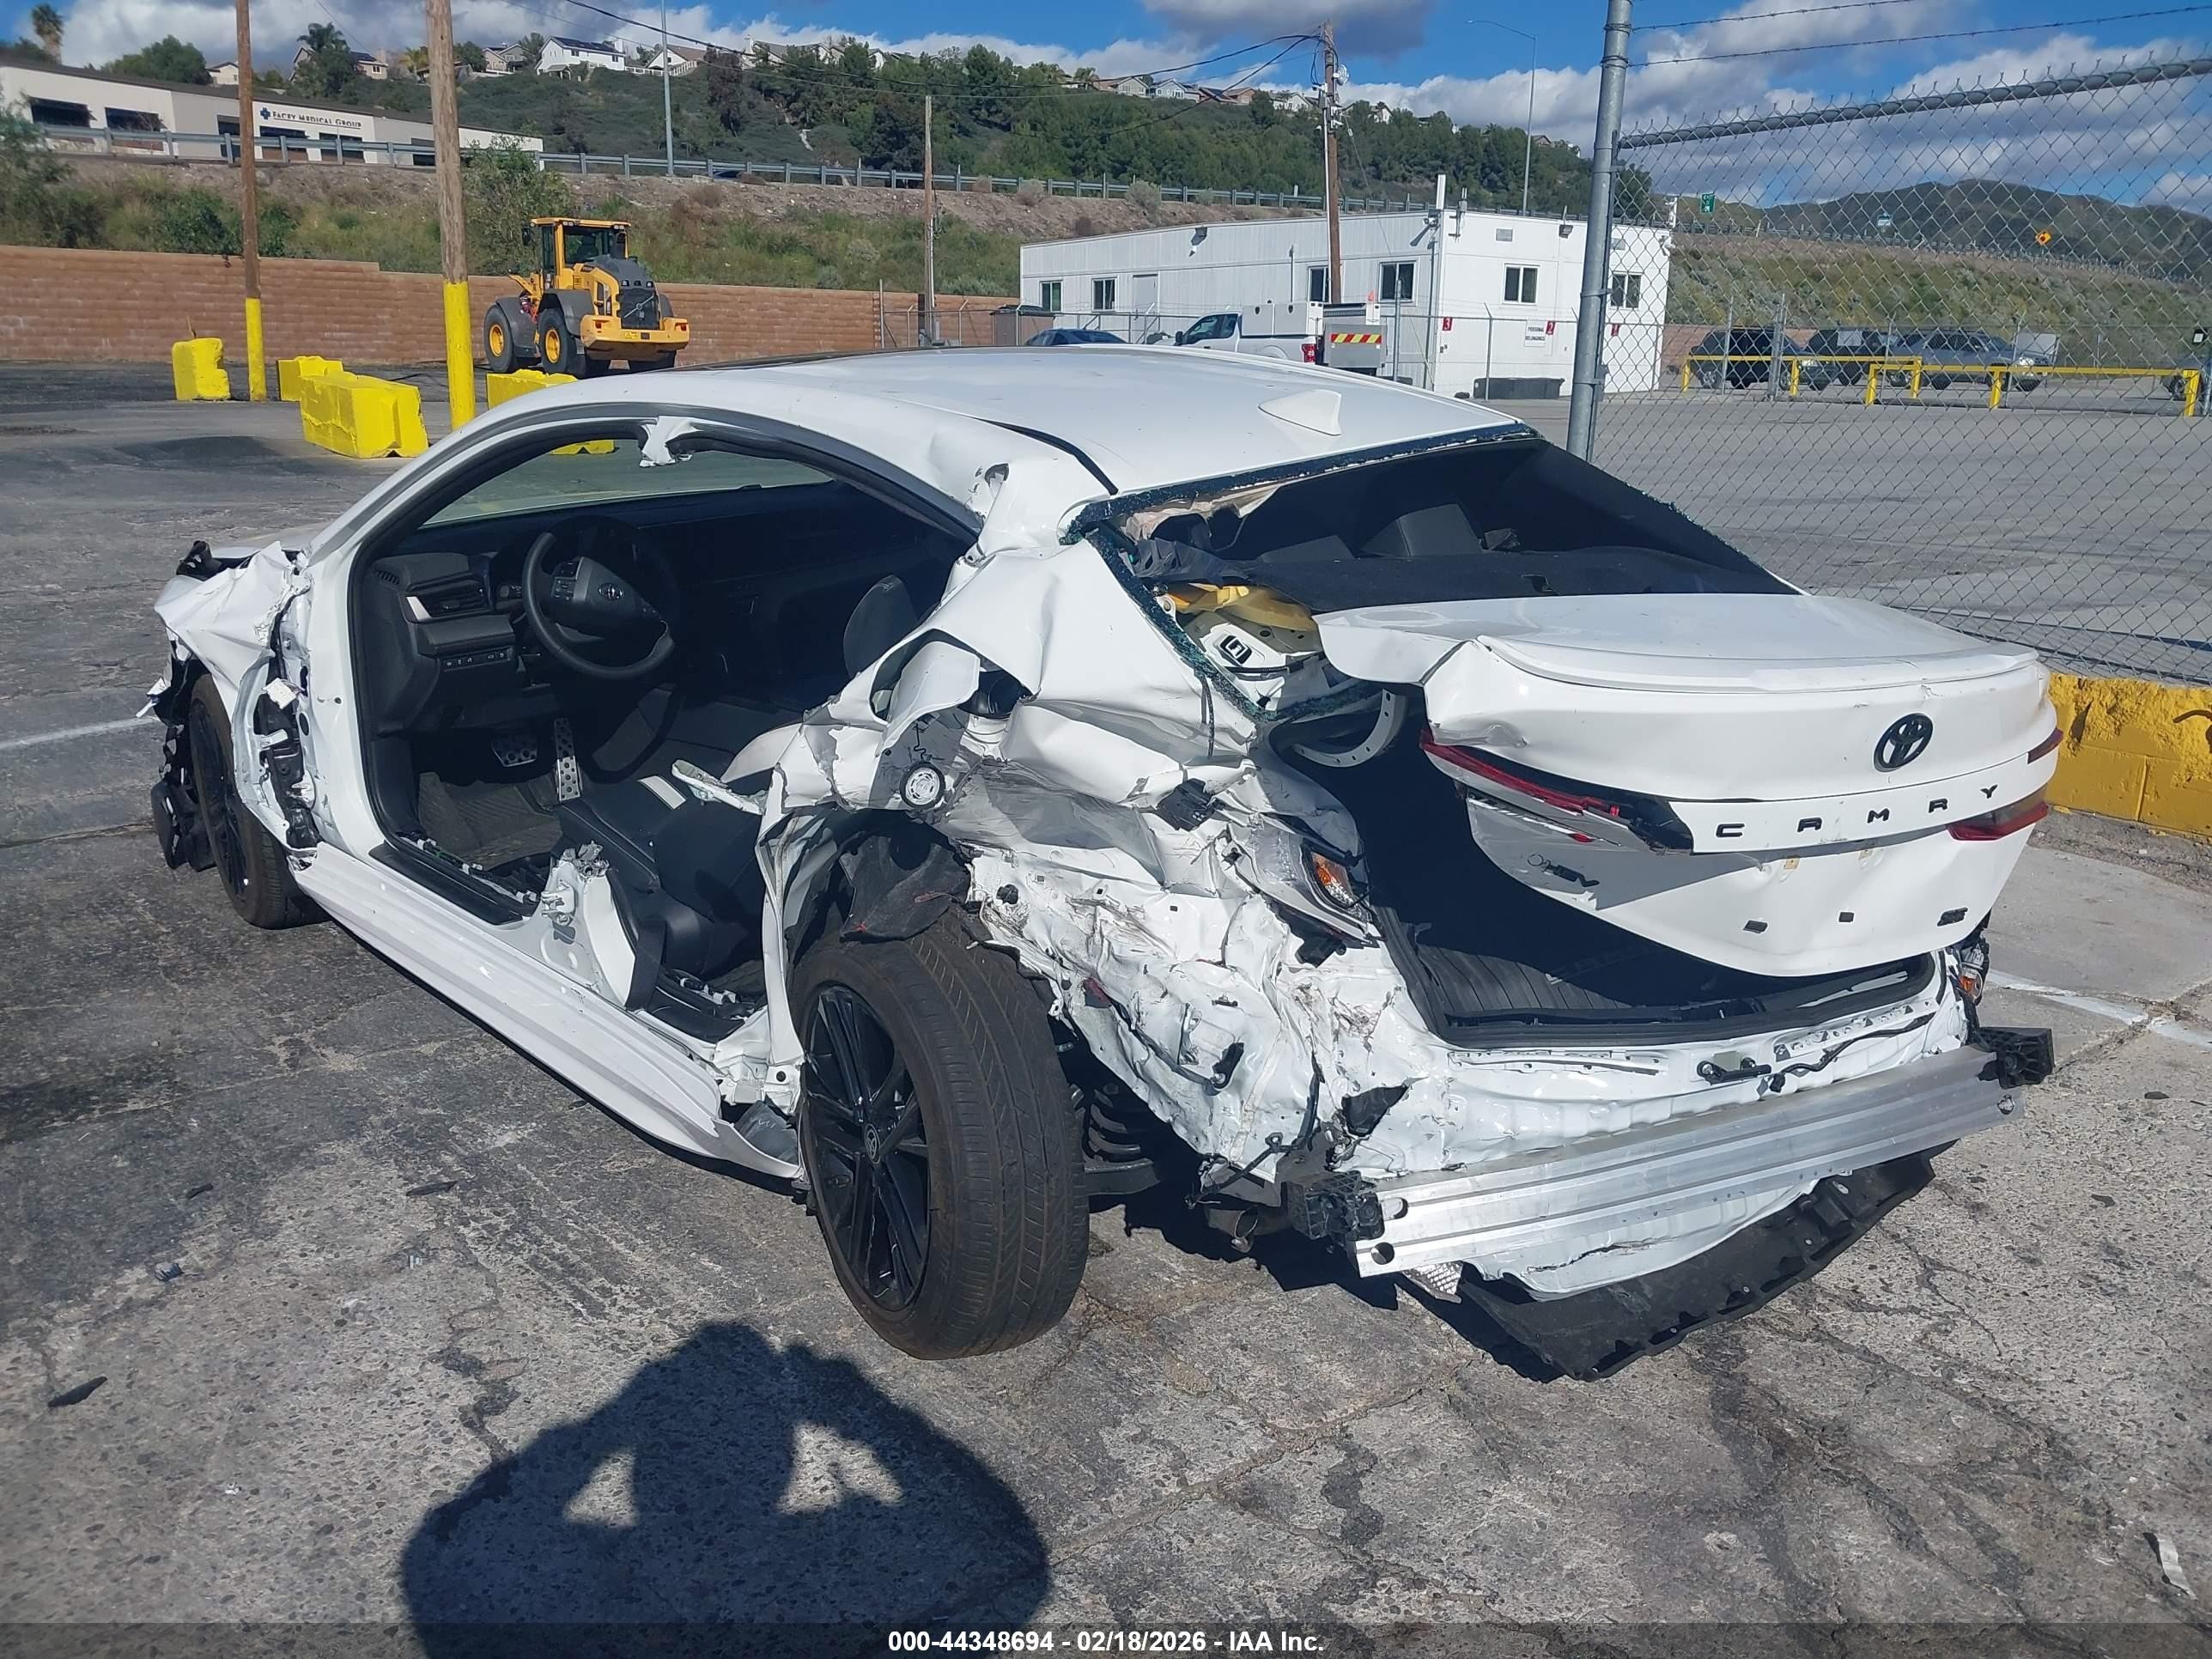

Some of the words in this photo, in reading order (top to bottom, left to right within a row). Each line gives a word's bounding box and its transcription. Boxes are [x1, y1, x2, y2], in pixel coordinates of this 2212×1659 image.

[299, 114, 332, 125] MEDICAL
[336, 118, 362, 128] GROUP
[1716, 784, 1998, 838] CAMRY
